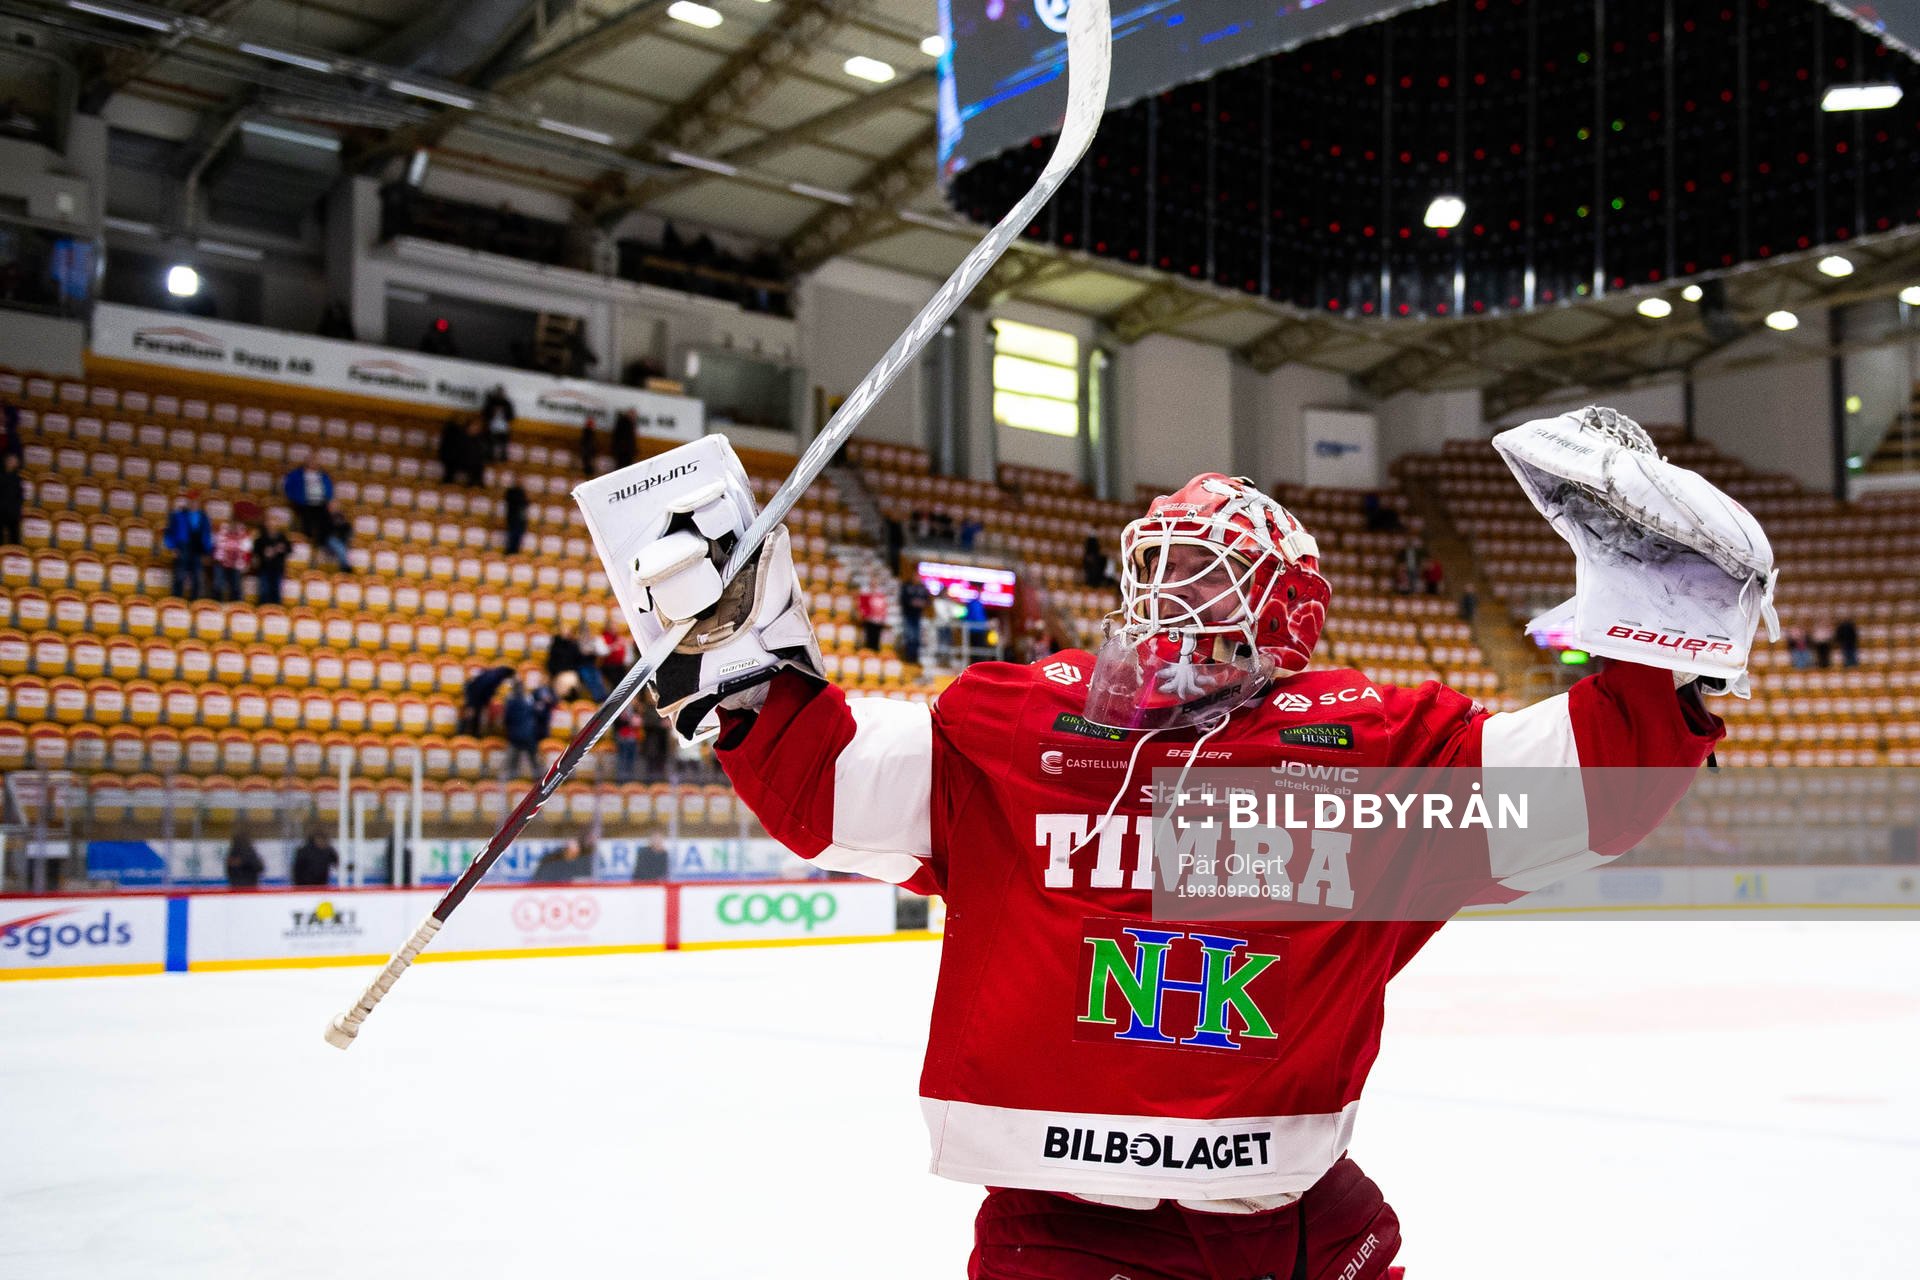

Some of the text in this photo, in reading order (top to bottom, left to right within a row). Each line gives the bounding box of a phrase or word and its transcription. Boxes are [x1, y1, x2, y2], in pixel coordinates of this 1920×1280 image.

[607, 459, 702, 505] SUPREME
[1318, 686, 1383, 705] SCA
[1302, 734, 1339, 745] HUSET
[1066, 758, 1128, 769] CASTELLUM
[1166, 749, 1233, 759] BAUER
[1271, 760, 1360, 783] JOWIC
[1275, 779, 1352, 796] elteknik ab
[716, 891, 838, 931] coop
[1077, 927, 1281, 1050] NHK
[1043, 1125, 1272, 1171] BILBOLAGET
